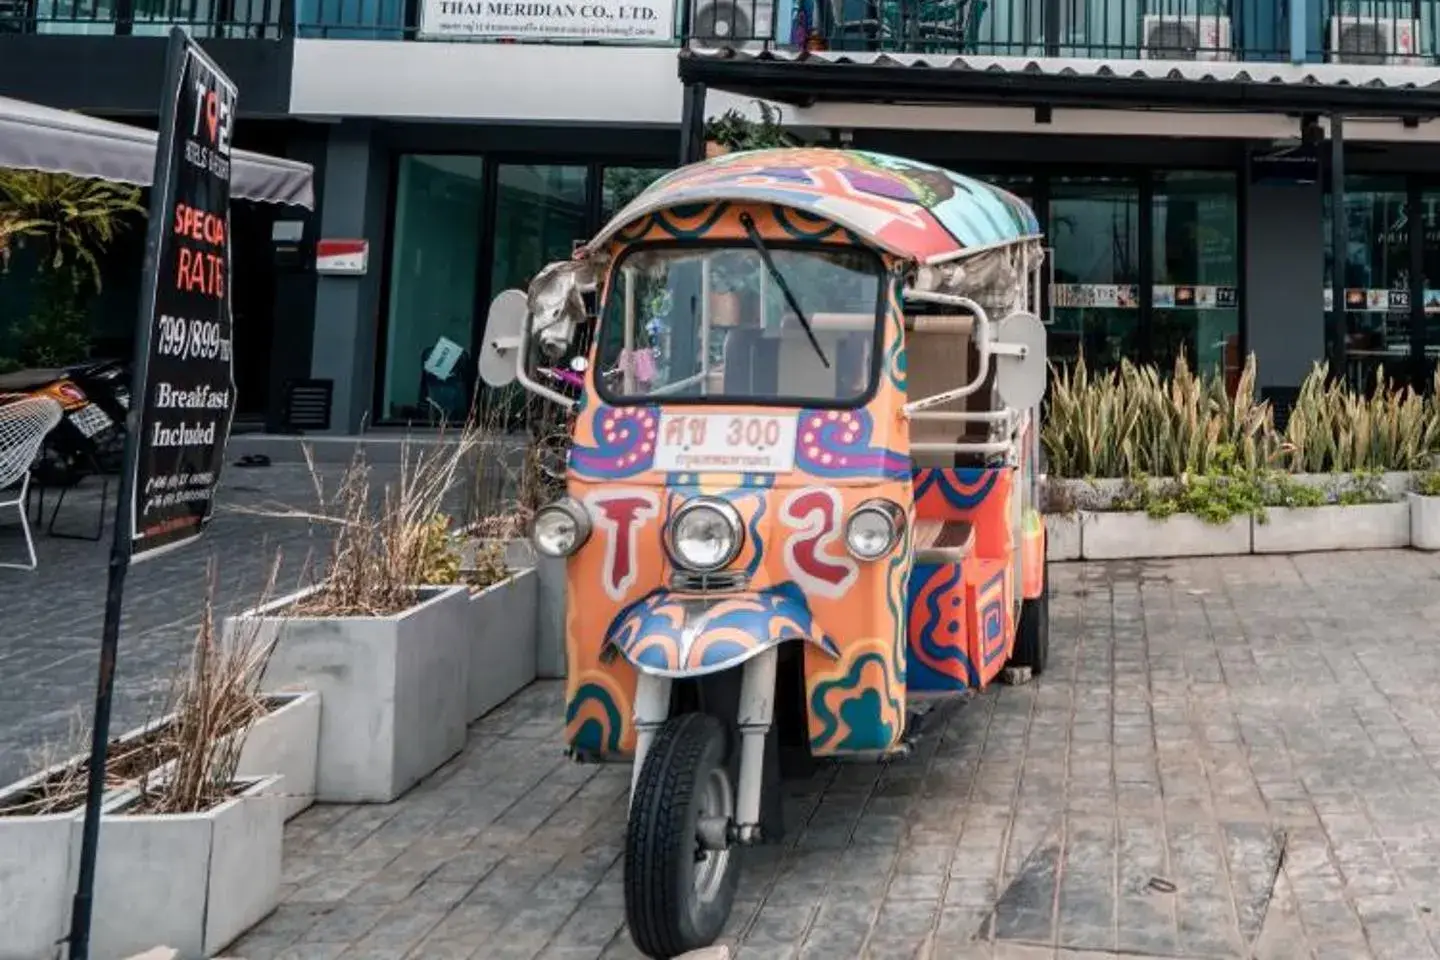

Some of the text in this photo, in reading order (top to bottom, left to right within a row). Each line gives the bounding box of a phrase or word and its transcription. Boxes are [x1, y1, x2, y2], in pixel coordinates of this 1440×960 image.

[439, 0, 482, 16] THAI
[486, 1, 576, 18] MERIDIAN
[619, 6, 658, 21] LTD.
[174, 202, 227, 246] SPECIA
[156, 382, 229, 409] Breakfast
[151, 421, 215, 447] Included
[726, 417, 780, 447] 300
[588, 487, 855, 596] T 2
